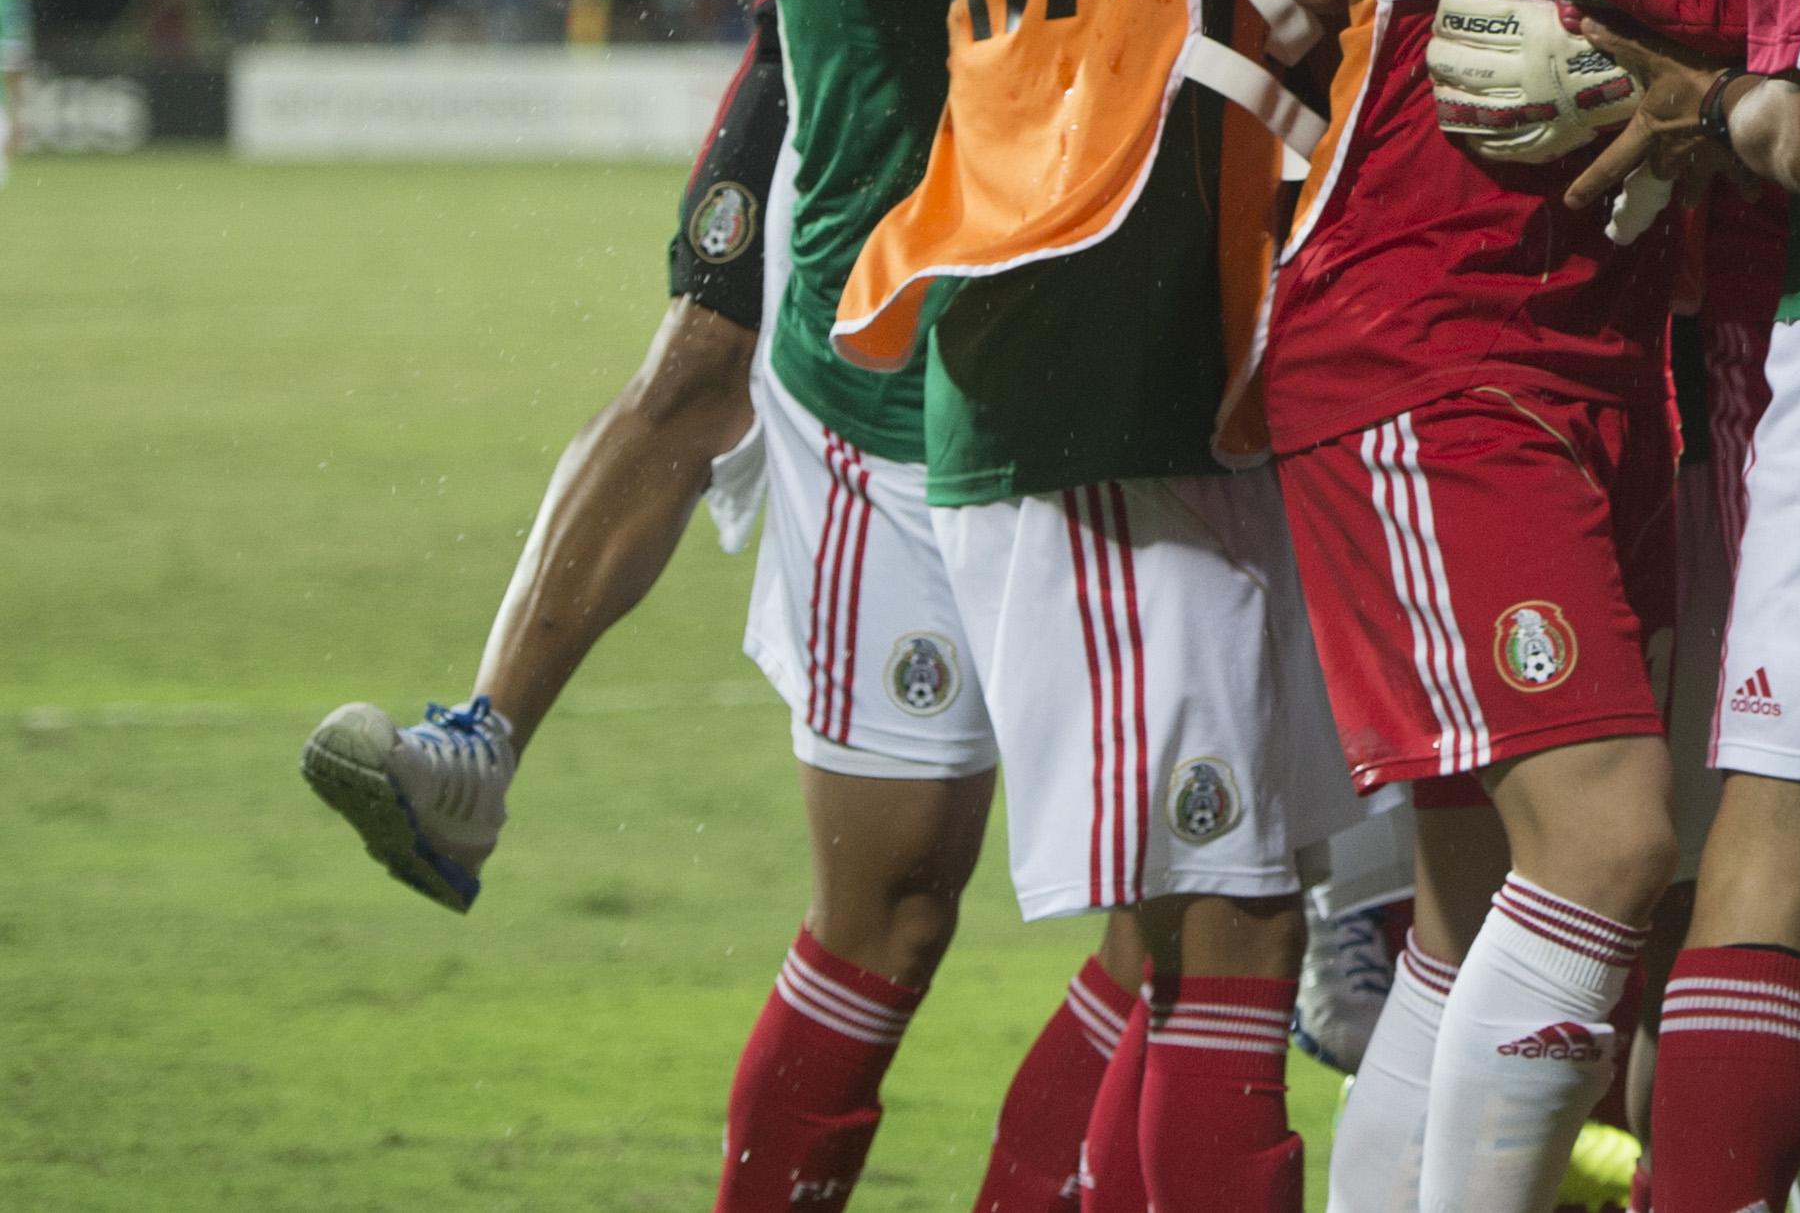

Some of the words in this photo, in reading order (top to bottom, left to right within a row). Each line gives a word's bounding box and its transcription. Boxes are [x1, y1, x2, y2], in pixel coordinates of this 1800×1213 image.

[1442, 12, 1521, 36] reusch
[1730, 696, 1782, 717] adidas
[1497, 1041, 1603, 1062] adidas
